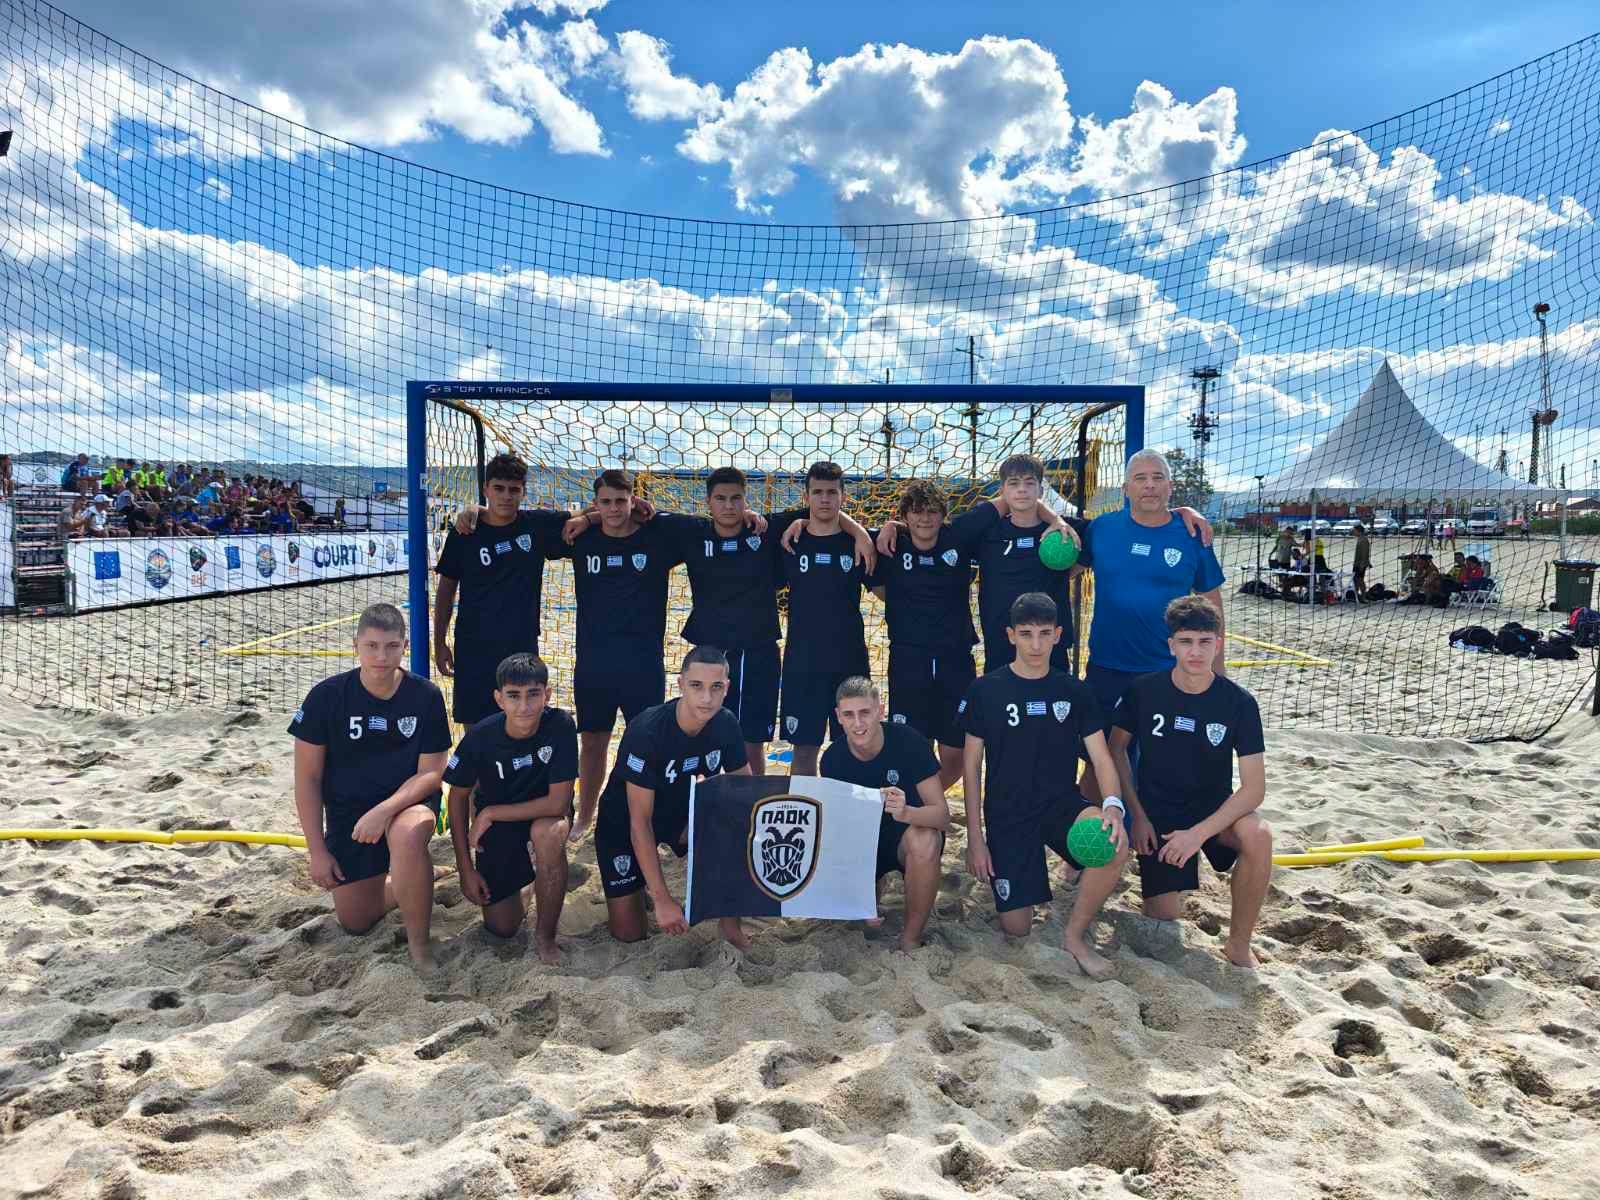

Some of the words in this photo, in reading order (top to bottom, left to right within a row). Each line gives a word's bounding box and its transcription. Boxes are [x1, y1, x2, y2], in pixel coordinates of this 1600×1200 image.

[314, 544, 357, 568] COURT
[480, 547, 491, 566] 6
[704, 540, 713, 557] 11
[586, 554, 601, 574] 10
[799, 554, 809, 573] 9
[903, 552, 913, 570] 8
[1006, 703, 1020, 727] 3
[1152, 713, 1165, 736] 2
[349, 716, 363, 740] 5
[495, 760, 505, 780] 1
[665, 759, 678, 784] 4
